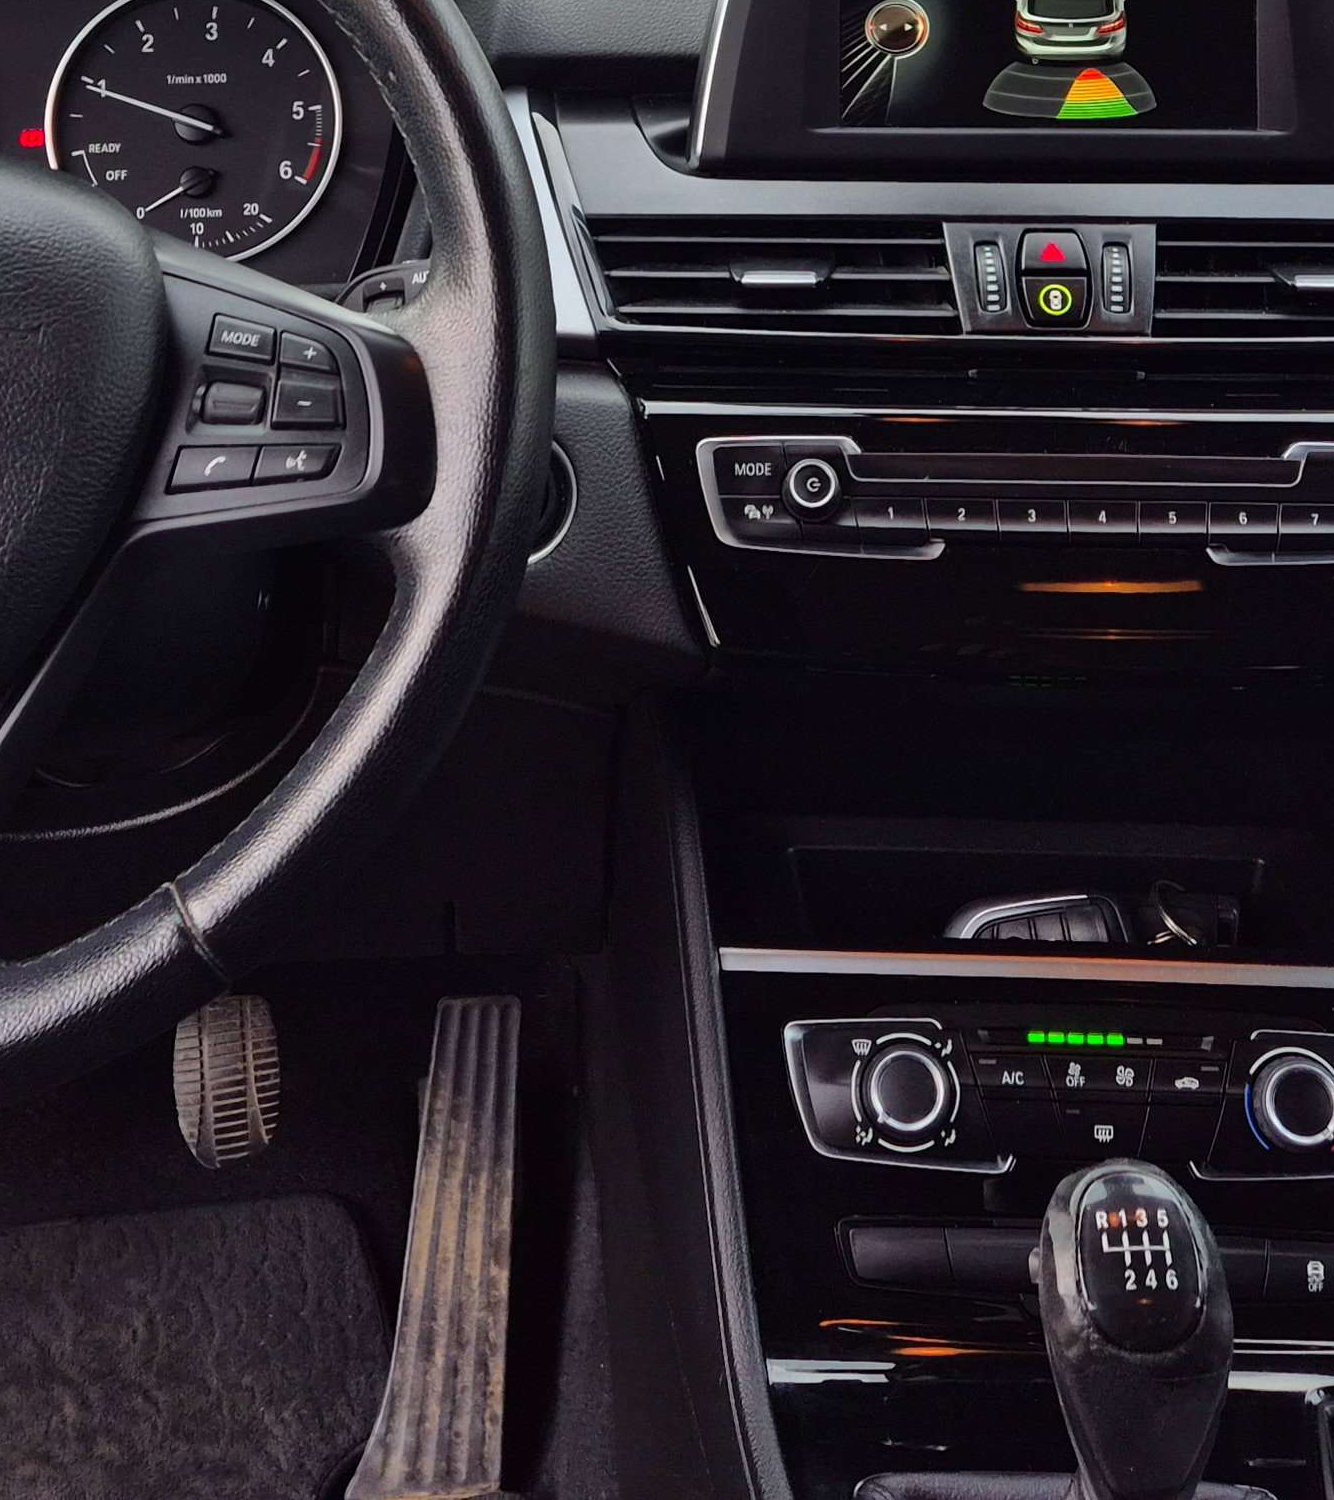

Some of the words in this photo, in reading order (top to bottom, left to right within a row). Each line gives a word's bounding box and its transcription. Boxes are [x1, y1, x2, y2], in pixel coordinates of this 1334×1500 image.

[205, 22, 219, 41] 3
[141, 34, 155, 53] 2
[261, 49, 275, 67] 4
[203, 73, 227, 84] 1000
[97, 79, 106, 98] 1
[291, 101, 304, 120] 5
[88, 143, 122, 154] READY
[105, 169, 128, 181] OFF
[279, 160, 293, 179] 6
[136, 207, 145, 220] 0
[206, 207, 223, 218] km
[243, 203, 259, 216] 20
[190, 222, 205, 235] 10
[412, 270, 430, 285] AU
[220, 330, 261, 348] MODE
[734, 462, 772, 476] MODE
[887, 506, 894, 520] 1
[957, 507, 966, 522] 2
[1027, 508, 1036, 523] 3
[1098, 510, 1107, 524] 4
[1168, 511, 1177, 525] 5
[1238, 511, 1248, 525] 6
[1310, 513, 1319, 527] 7
[1002, 1070, 1025, 1086] A/C
[1066, 1075, 1086, 1088] OFF
[1095, 1209, 1109, 1231] R
[1118, 1207, 1127, 1229] 1
[1135, 1207, 1148, 1228] 3
[1157, 1208, 1169, 1229] 5
[1124, 1268, 1137, 1291] 2
[1145, 1268, 1158, 1291] 4
[1165, 1268, 1179, 1291] 6
